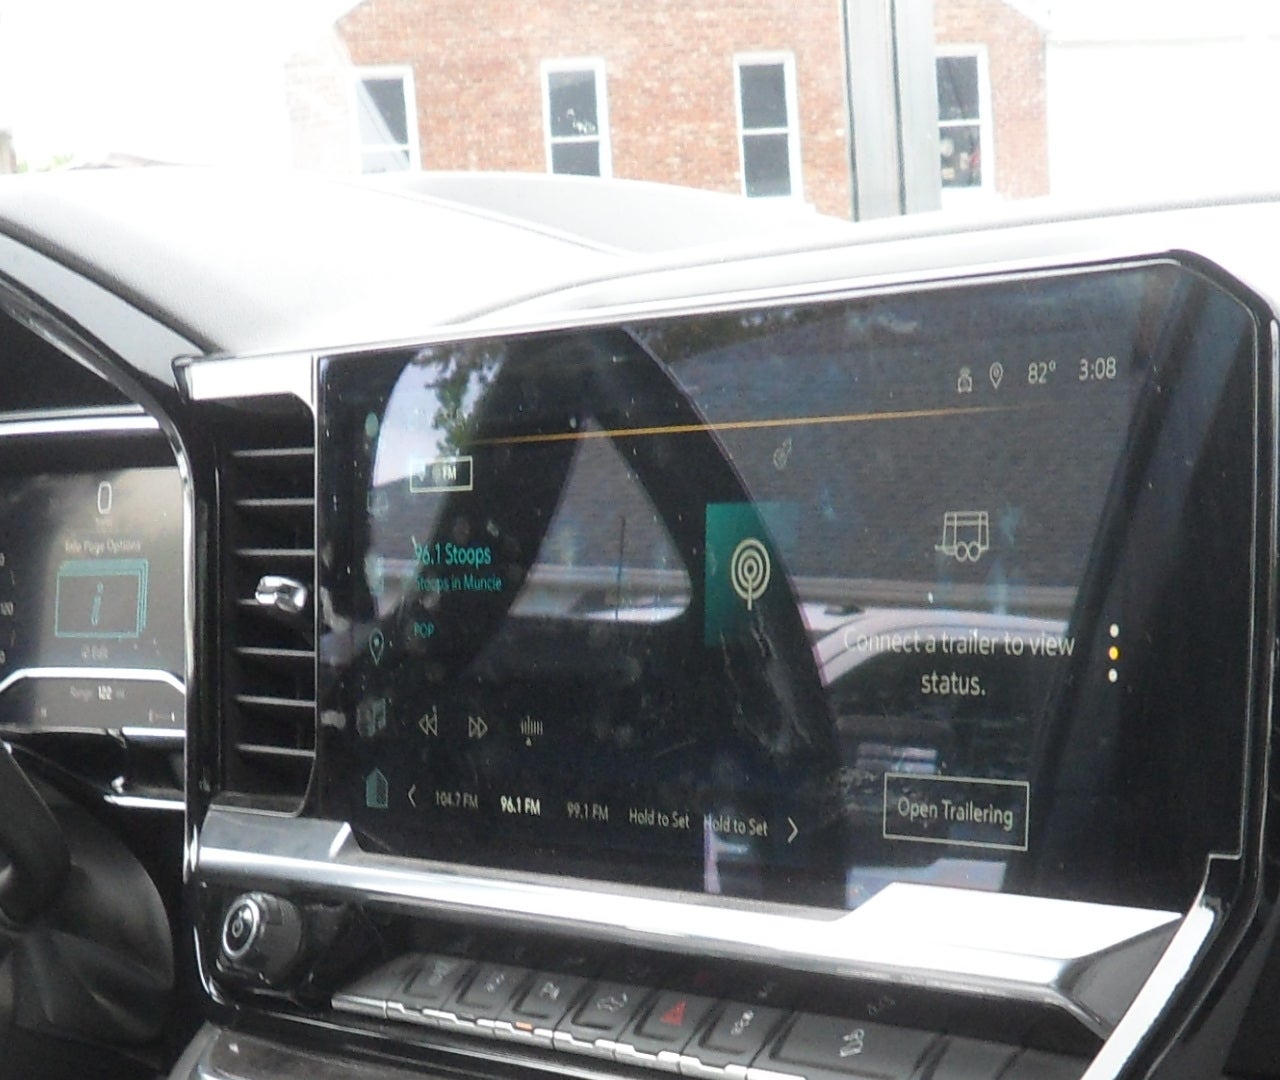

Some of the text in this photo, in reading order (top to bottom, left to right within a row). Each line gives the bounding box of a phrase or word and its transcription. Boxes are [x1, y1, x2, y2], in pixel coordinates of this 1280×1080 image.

[1078, 355, 1117, 381] 3:08
[97, 480, 112, 514] 0
[445, 542, 492, 569] Stoops
[451, 574, 462, 591] in
[463, 573, 502, 592] Muncie
[843, 628, 1075, 657] Connect a trailer to view
[920, 670, 987, 696] status.
[463, 791, 479, 809] FM
[500, 795, 541, 816] 96.1 FM
[566, 801, 609, 822] 99.1 FM
[629, 807, 690, 830] Hold to Set
[703, 813, 768, 838] Hold to Set
[897, 796, 1014, 832] Open Trailering
